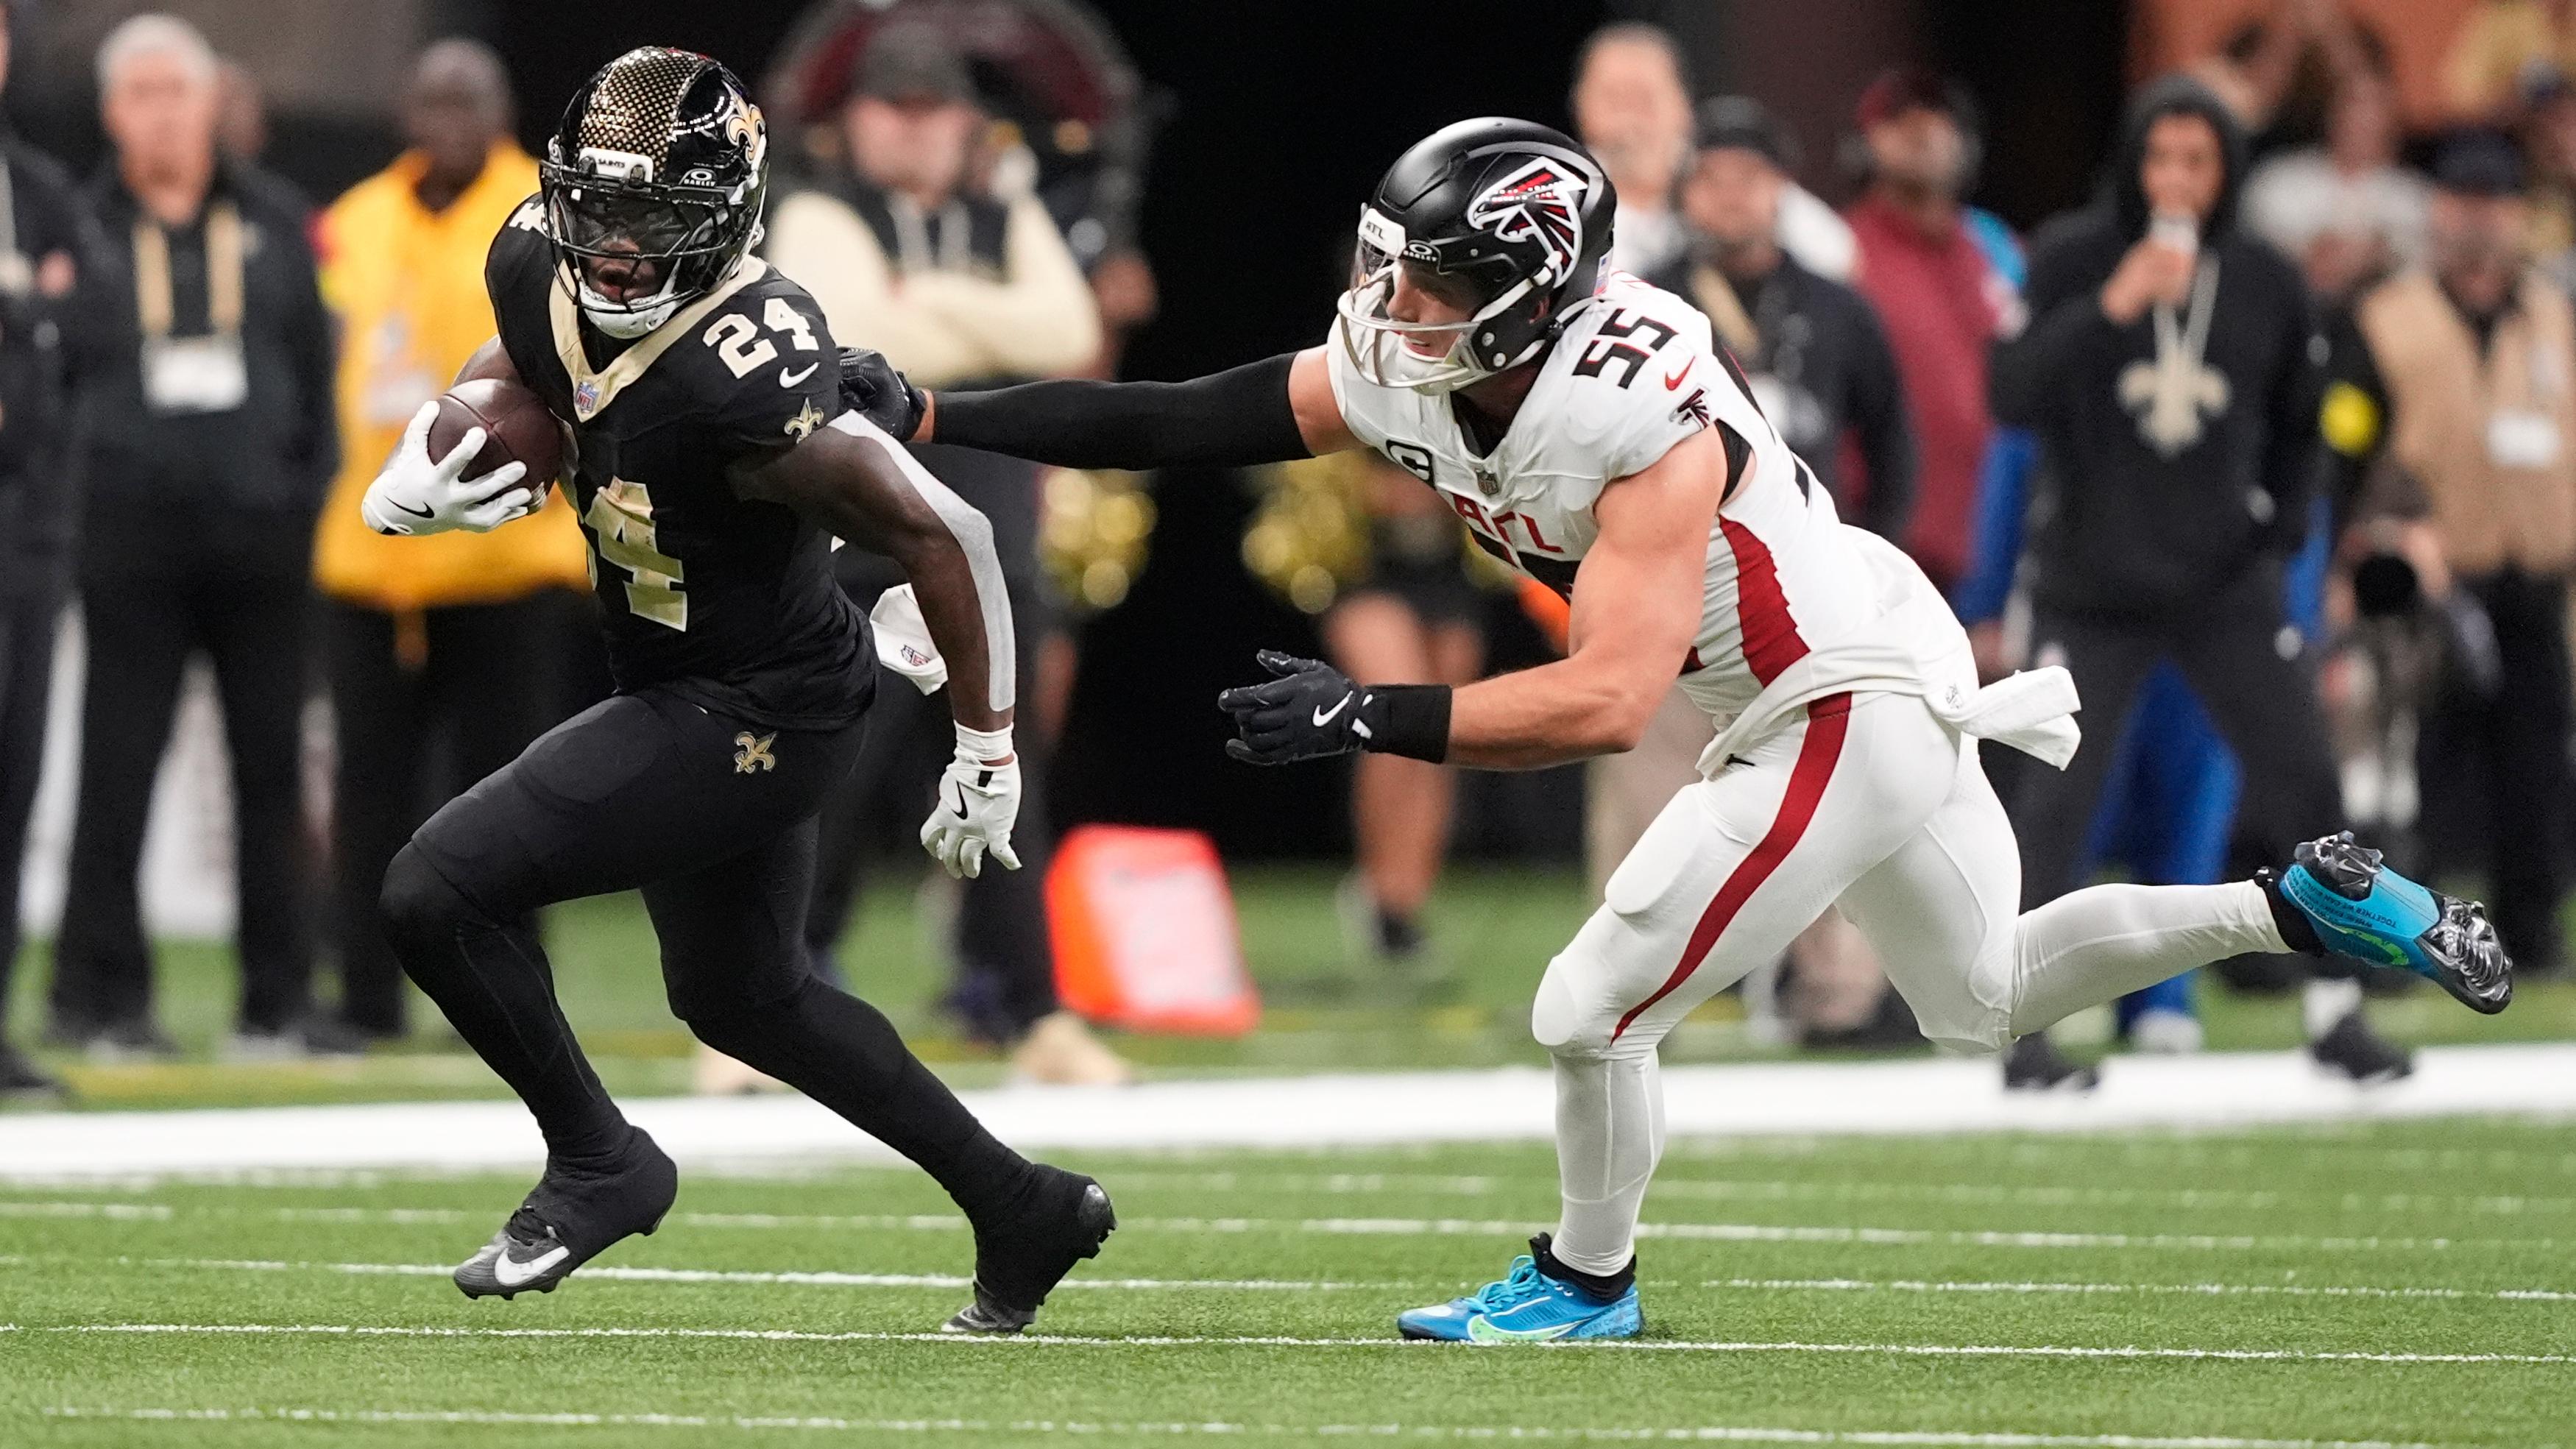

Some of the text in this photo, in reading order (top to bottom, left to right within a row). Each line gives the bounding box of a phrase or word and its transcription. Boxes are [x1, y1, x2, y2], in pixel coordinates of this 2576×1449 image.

[1365, 220, 1384, 240] ATL
[702, 297, 819, 379] 24
[1571, 308, 1680, 390] 55
[1452, 492, 1565, 553] ATL
[2356, 907, 2397, 929] TOGETHER
